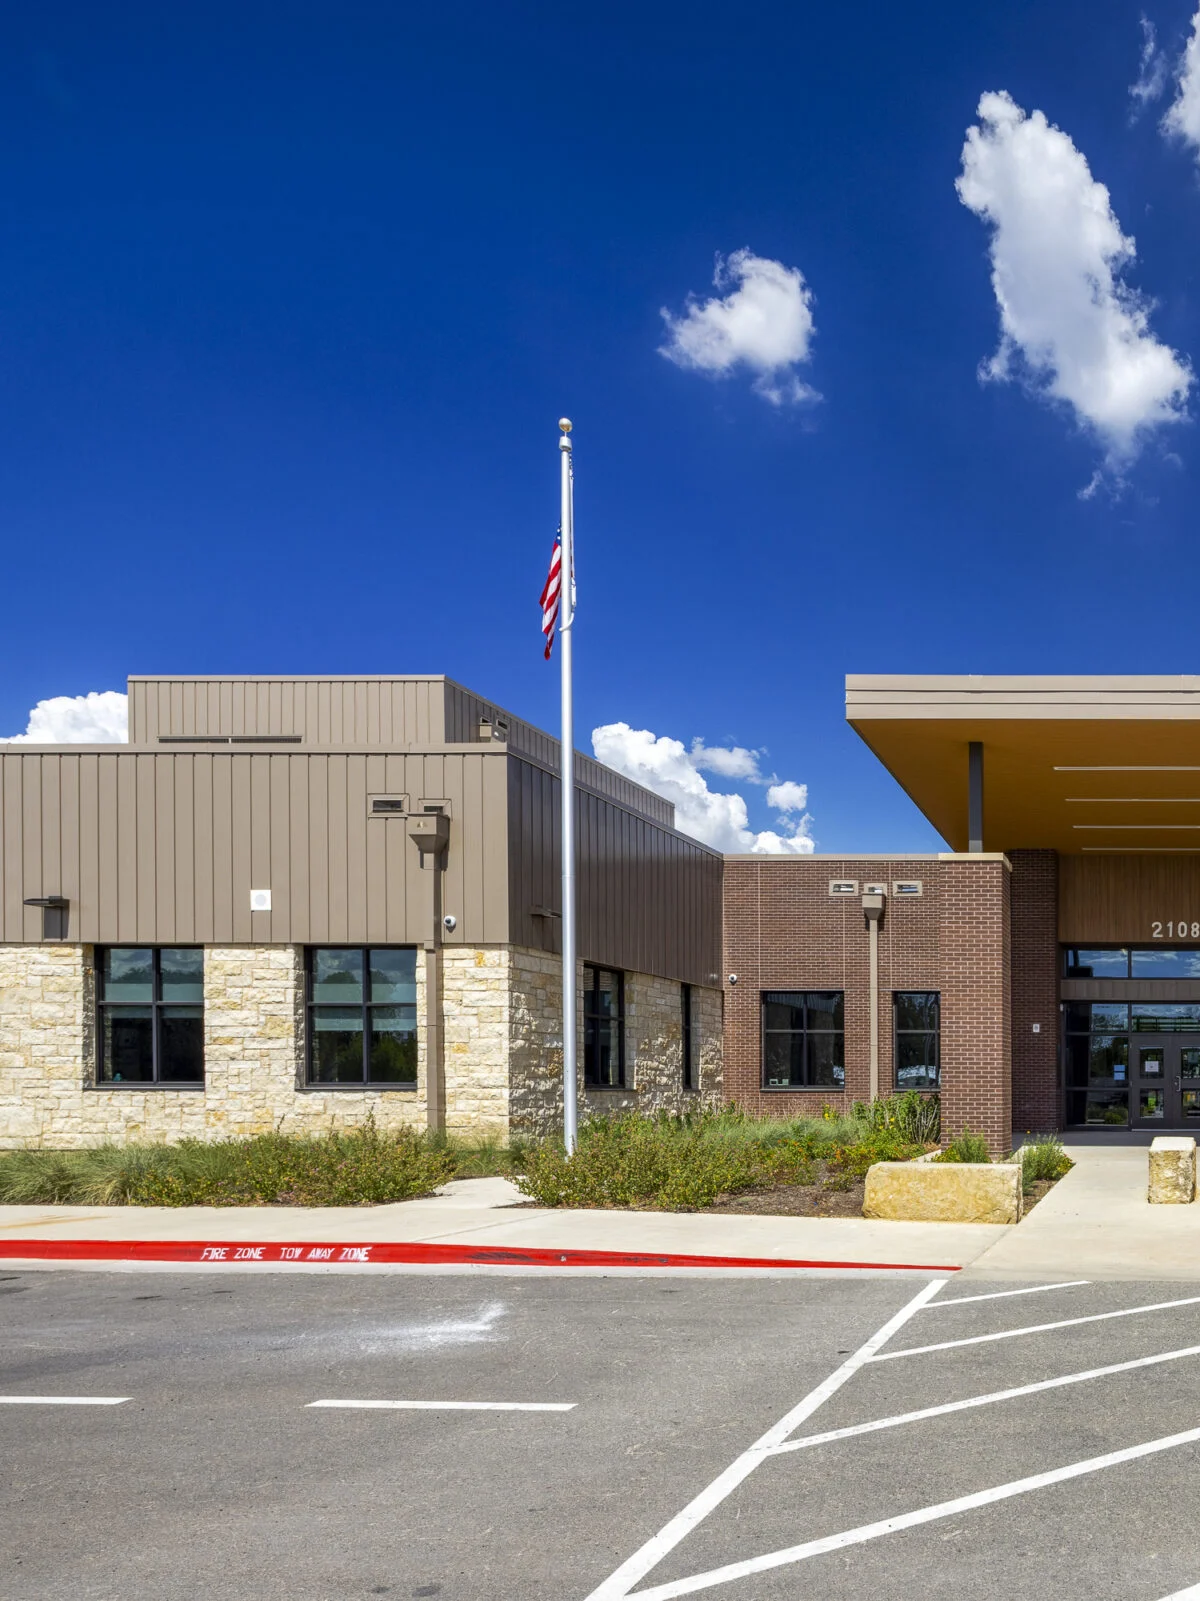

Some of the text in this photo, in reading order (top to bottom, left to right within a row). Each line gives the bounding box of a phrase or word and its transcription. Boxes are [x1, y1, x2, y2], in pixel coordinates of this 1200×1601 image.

[1151, 921, 1200, 938] 2108
[200, 1246, 372, 1261] FIRE ZONE TOW AWAY ZONE
